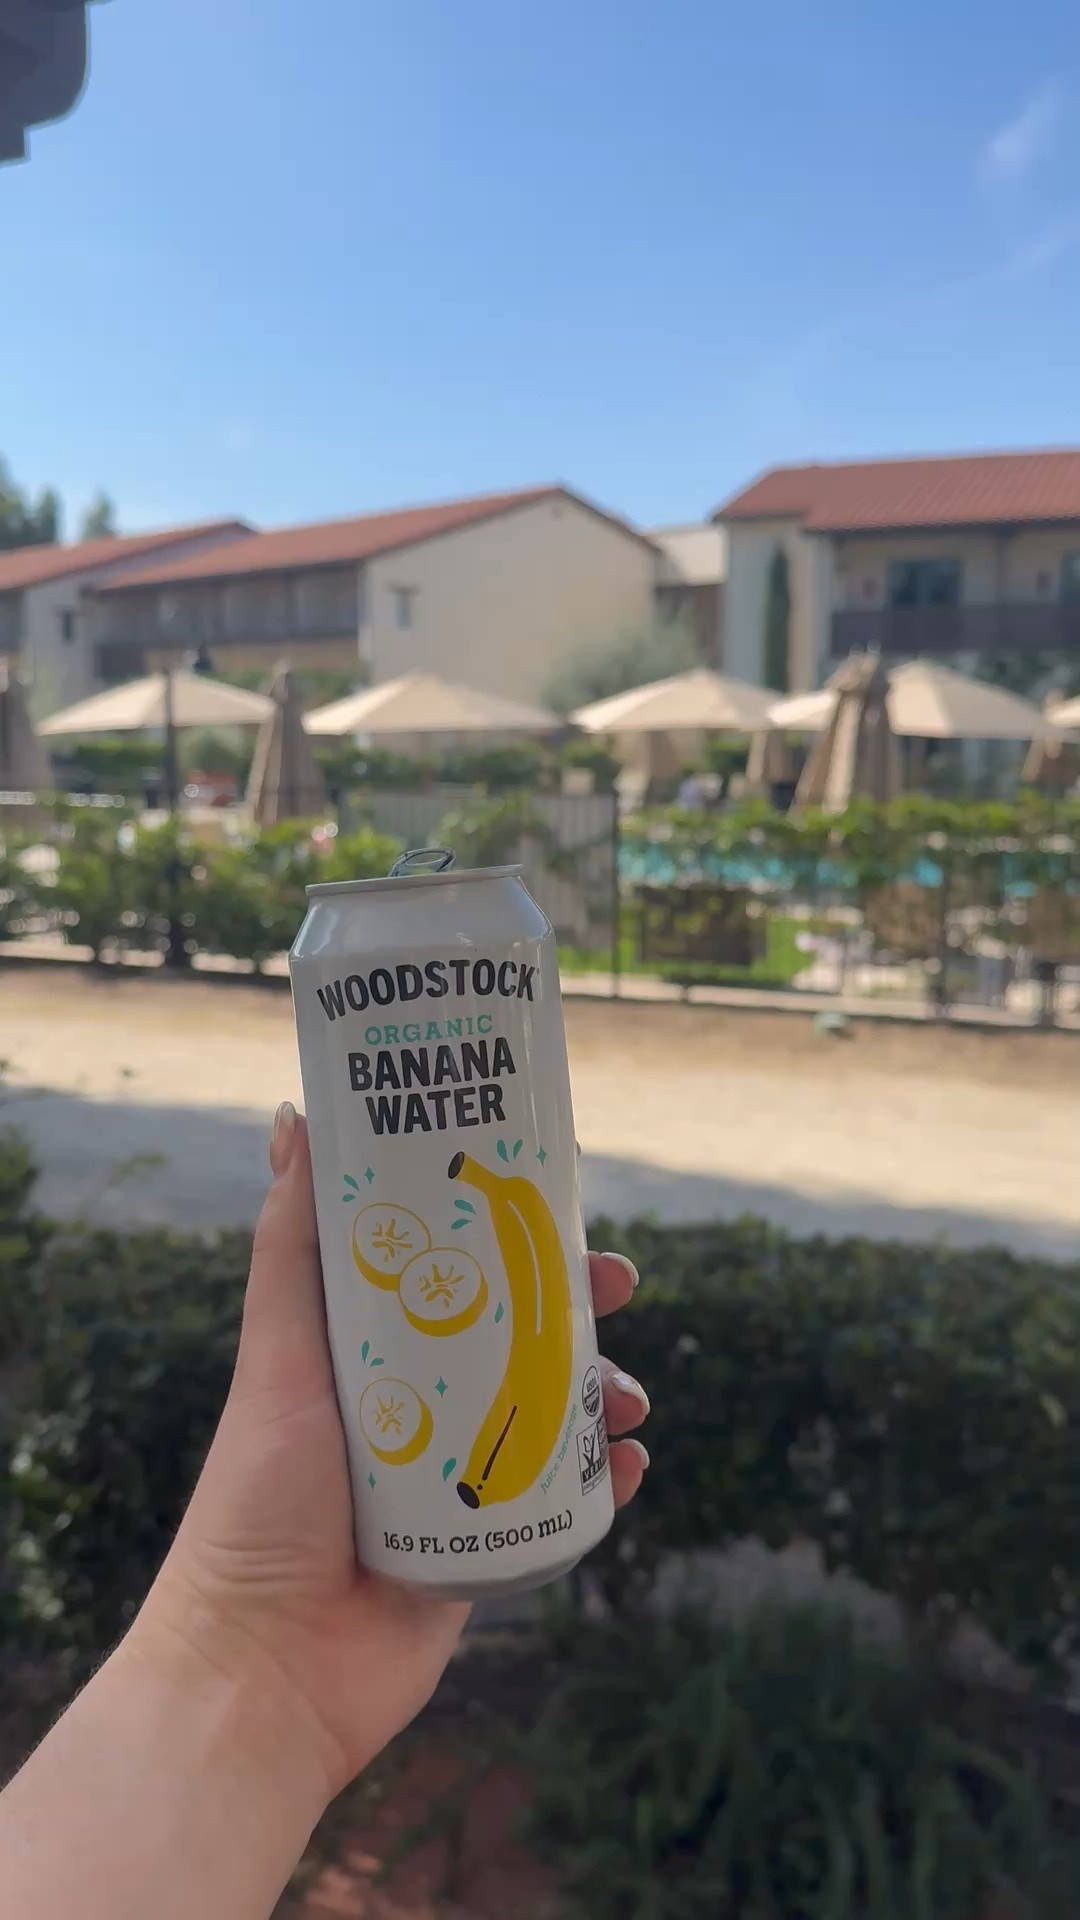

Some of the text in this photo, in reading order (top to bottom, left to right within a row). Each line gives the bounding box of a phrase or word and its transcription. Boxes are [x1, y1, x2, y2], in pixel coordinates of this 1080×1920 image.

[317, 958, 535, 1021] WOODSTOCK
[364, 1014, 493, 1046] ORGANIC
[348, 1037, 516, 1091] BANANA
[365, 1083, 506, 1135] WATER
[384, 1531, 414, 1551] 16.9
[419, 1536, 444, 1553] FL
[450, 1535, 479, 1553] OZ
[485, 1525, 533, 1552] (500
